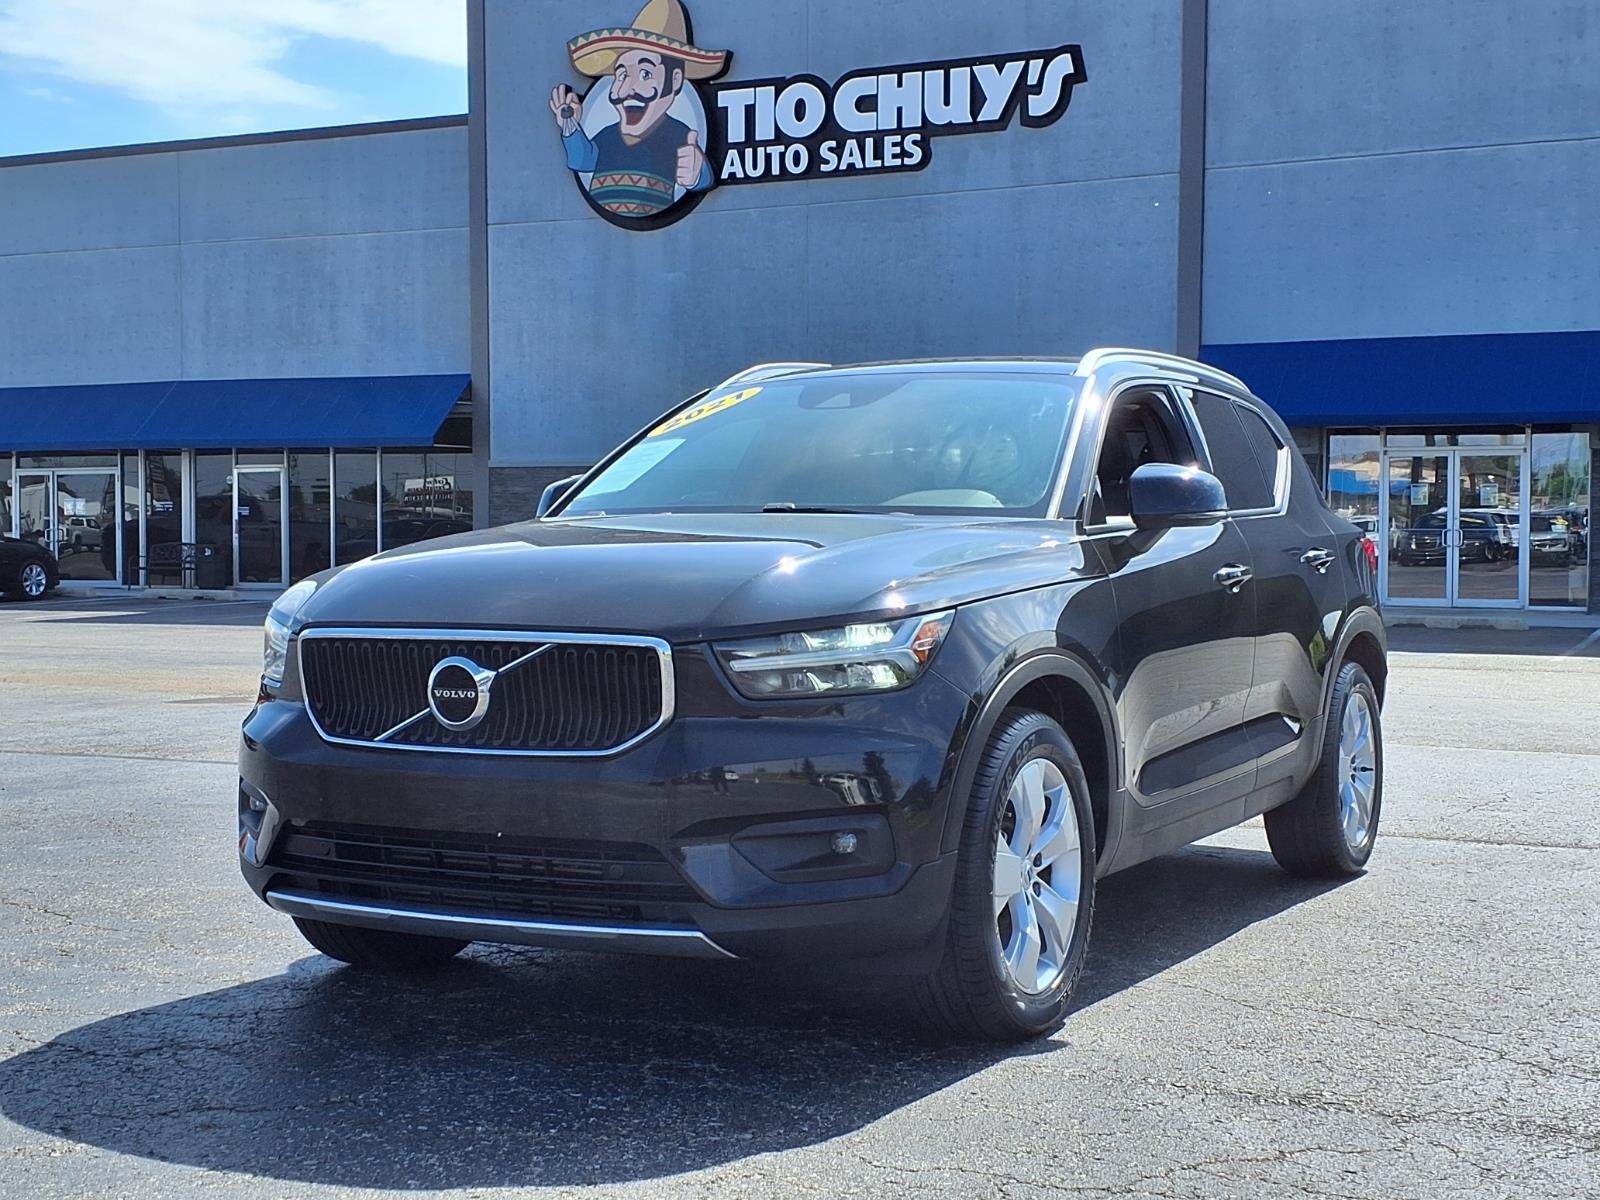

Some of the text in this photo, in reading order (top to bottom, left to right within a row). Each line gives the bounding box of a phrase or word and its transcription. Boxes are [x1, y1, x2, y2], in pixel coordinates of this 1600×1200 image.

[717, 53, 1074, 143] TIO CHUY'S
[721, 133, 922, 179] AUTO SALES
[662, 391, 744, 433] 2021
[433, 689, 476, 698] VOLVO
